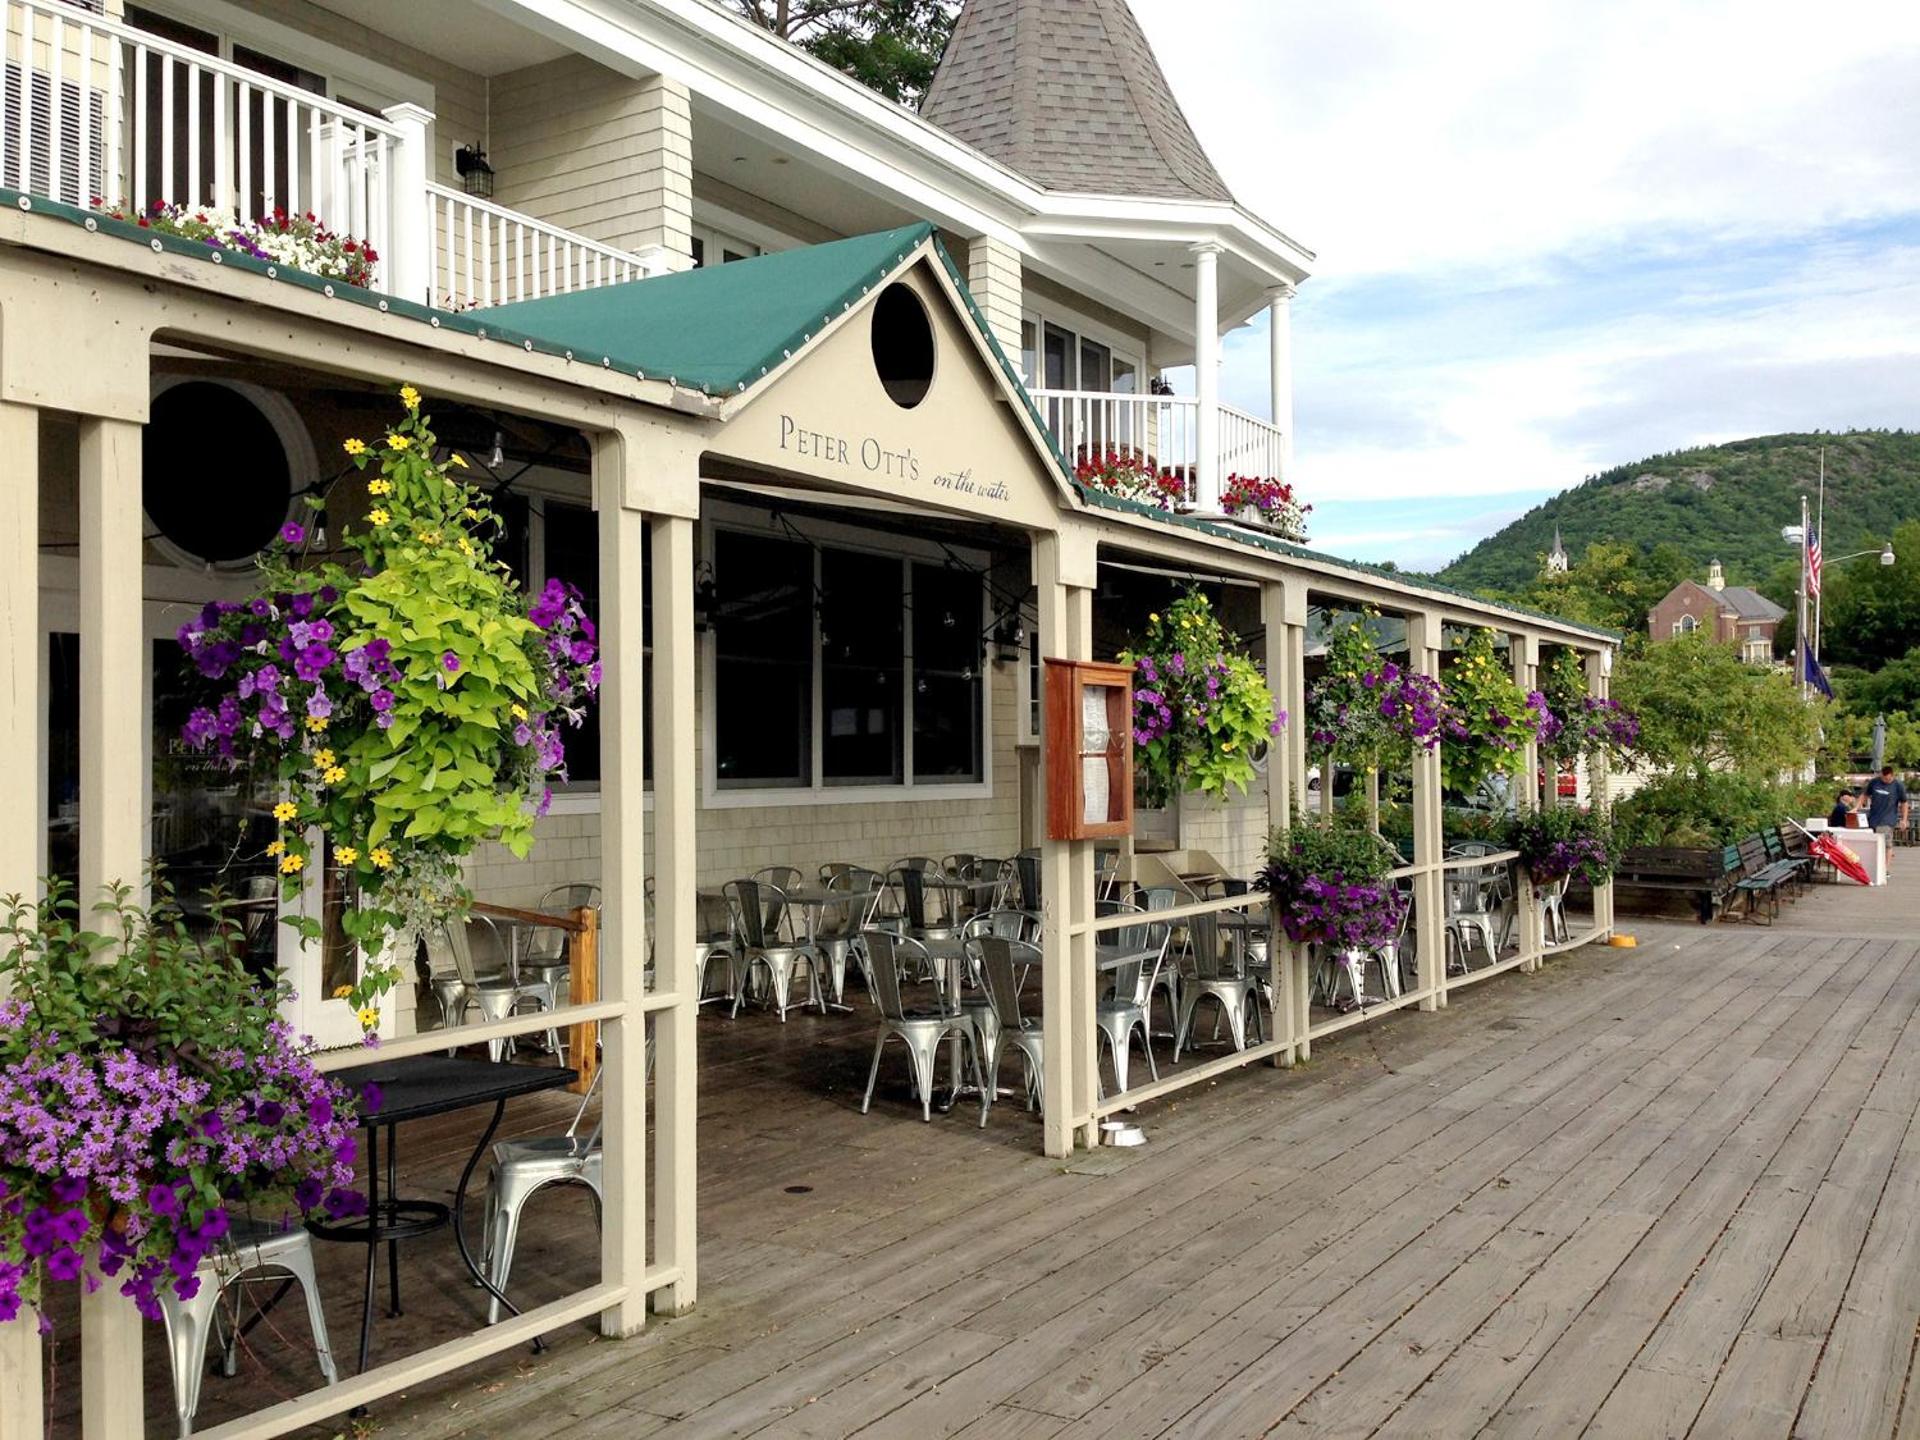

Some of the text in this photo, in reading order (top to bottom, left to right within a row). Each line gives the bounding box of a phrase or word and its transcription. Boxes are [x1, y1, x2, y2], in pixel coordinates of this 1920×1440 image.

[780, 414, 1009, 501] PETER OTT'S on the water
